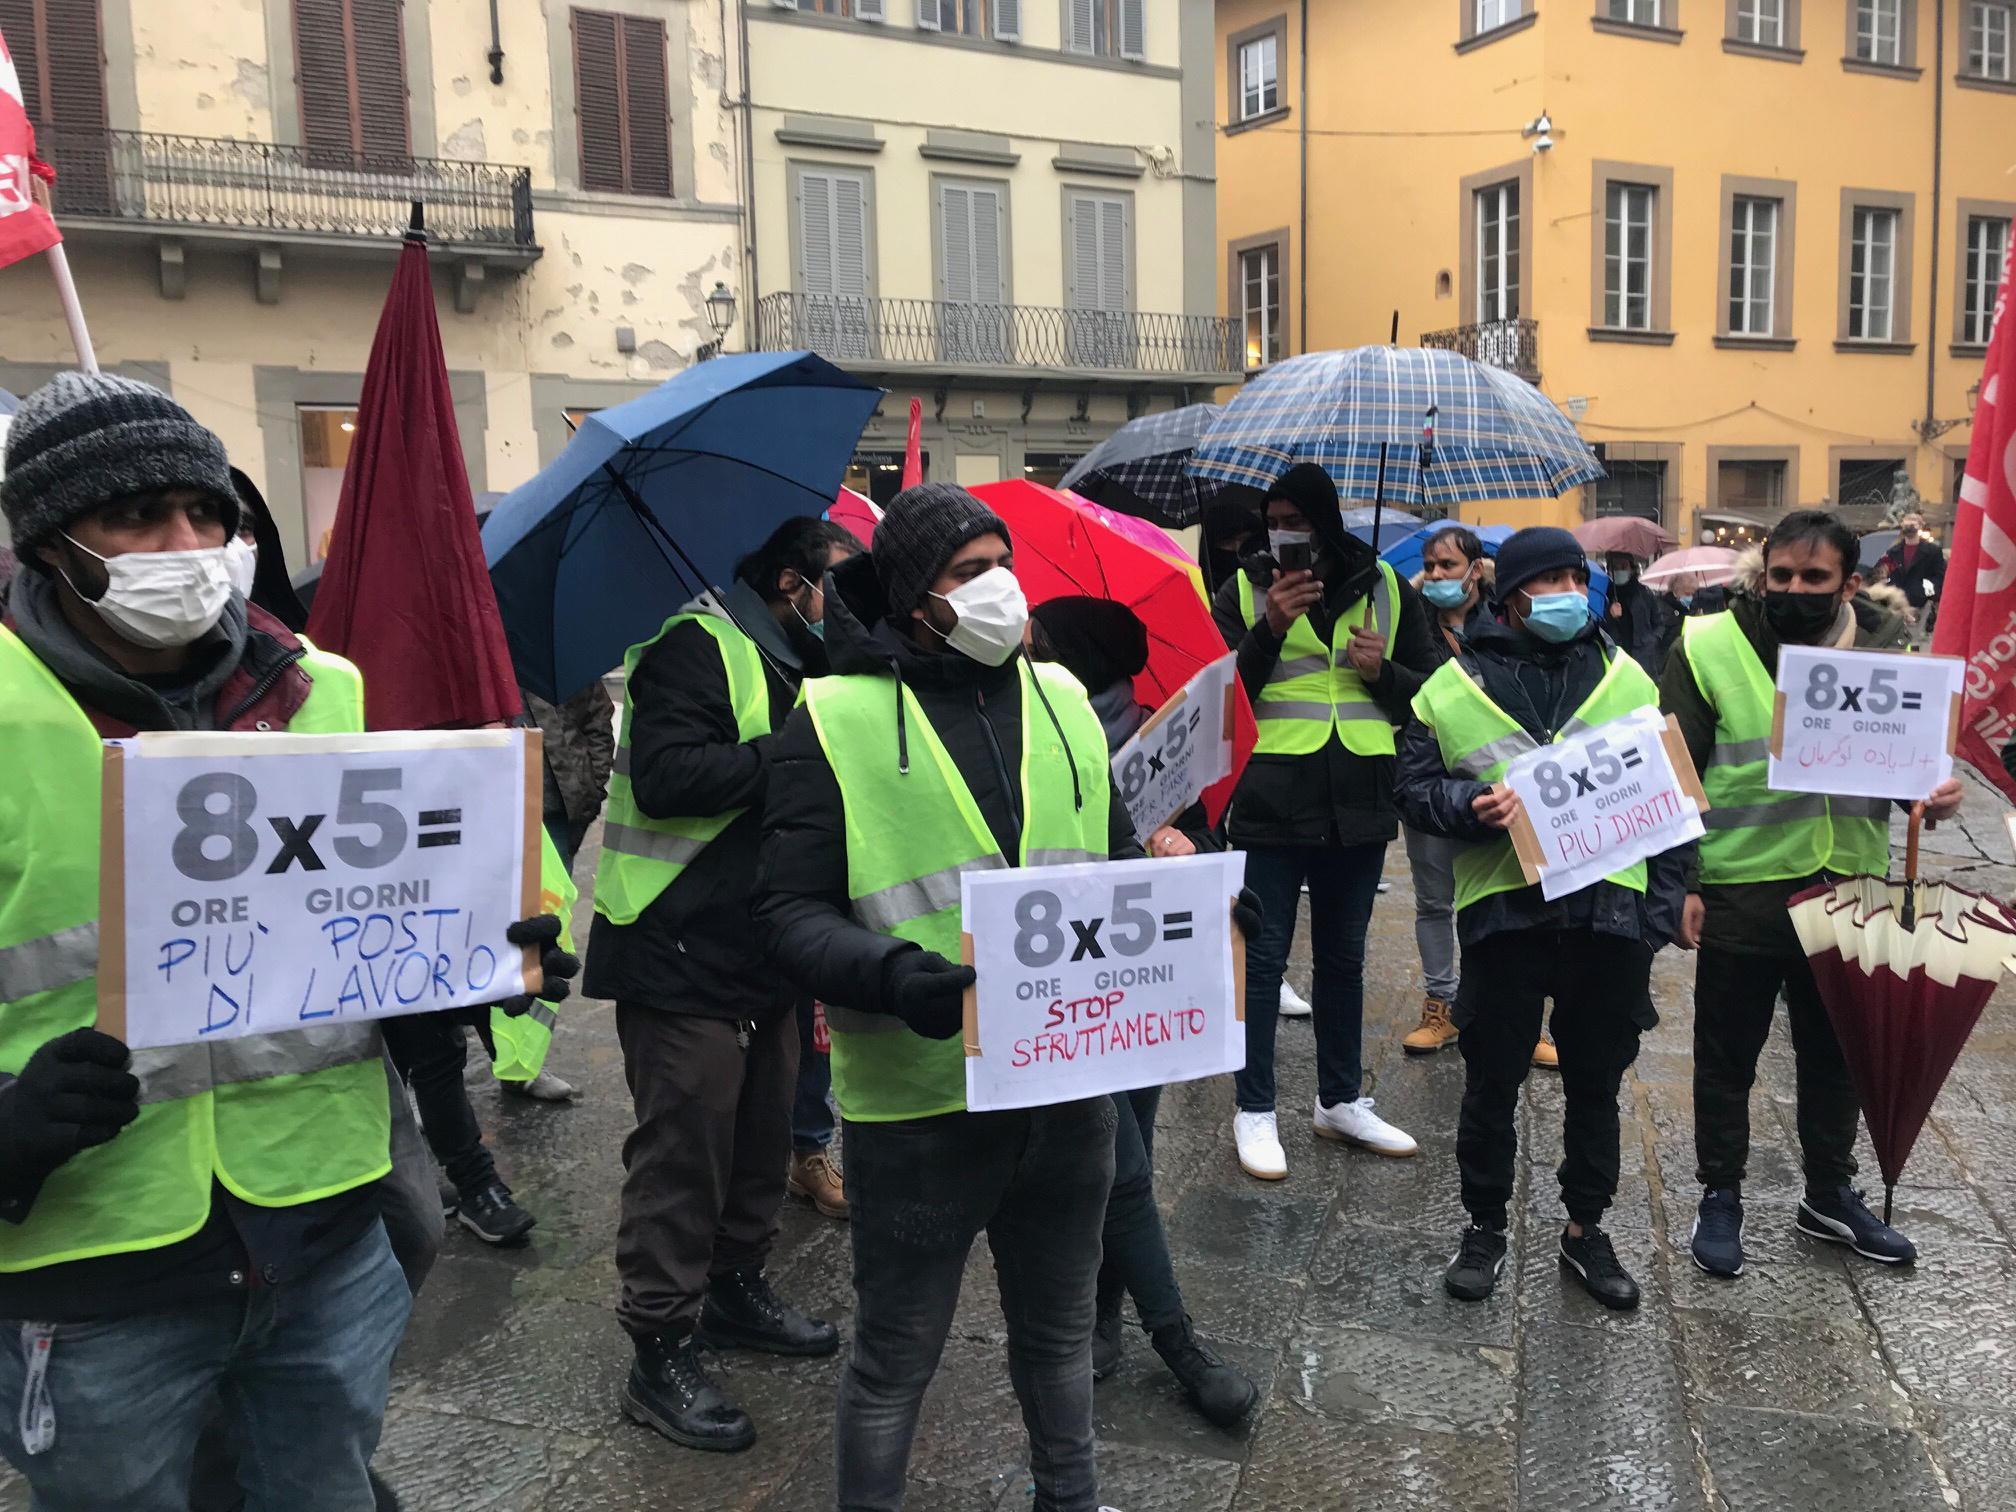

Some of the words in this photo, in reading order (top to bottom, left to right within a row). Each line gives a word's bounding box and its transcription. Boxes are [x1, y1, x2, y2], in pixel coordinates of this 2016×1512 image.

[1805, 663, 1922, 715] 8x5=
[1122, 706, 1200, 802] 8x5=
[1802, 716, 1831, 730] ORE
[1853, 720, 1906, 735] GIORNI
[1533, 738, 1643, 808] 8x5=
[172, 768, 461, 882] 8x5=
[1551, 809, 1578, 829] ORE
[1595, 782, 1642, 810] GIORNI
[1557, 816, 1602, 862] PIÙ
[1609, 789, 1681, 844] DIRITTI
[171, 896, 248, 927] ORE
[305, 879, 430, 914] GIORNI
[1013, 882, 1192, 968] 8x5=
[158, 921, 268, 983] PIÙ
[321, 909, 473, 961] POSTI
[198, 973, 254, 1034] DI
[299, 944, 495, 1020] LAVORO
[1015, 978, 1061, 1001] ORE
[1094, 964, 1174, 990] GIORNI
[1044, 991, 1124, 1028] STOP
[1011, 1008, 1205, 1067] SFRUTTAMENTO
